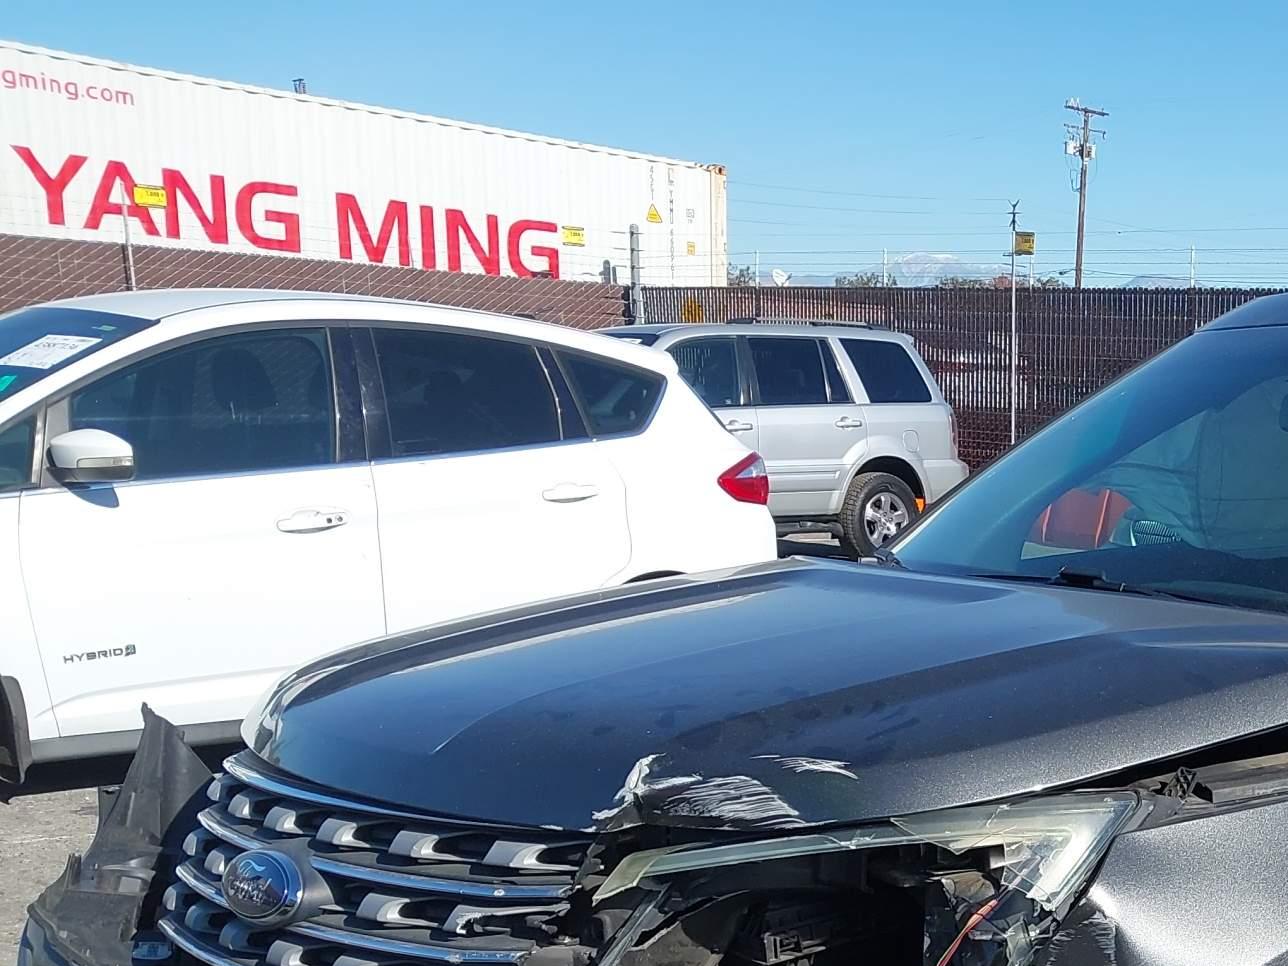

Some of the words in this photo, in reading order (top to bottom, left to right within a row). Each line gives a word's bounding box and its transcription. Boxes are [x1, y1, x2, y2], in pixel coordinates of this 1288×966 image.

[10, 144, 301, 253] YANG
[335, 192, 561, 280] MING
[63, 647, 124, 664] HYBRID
